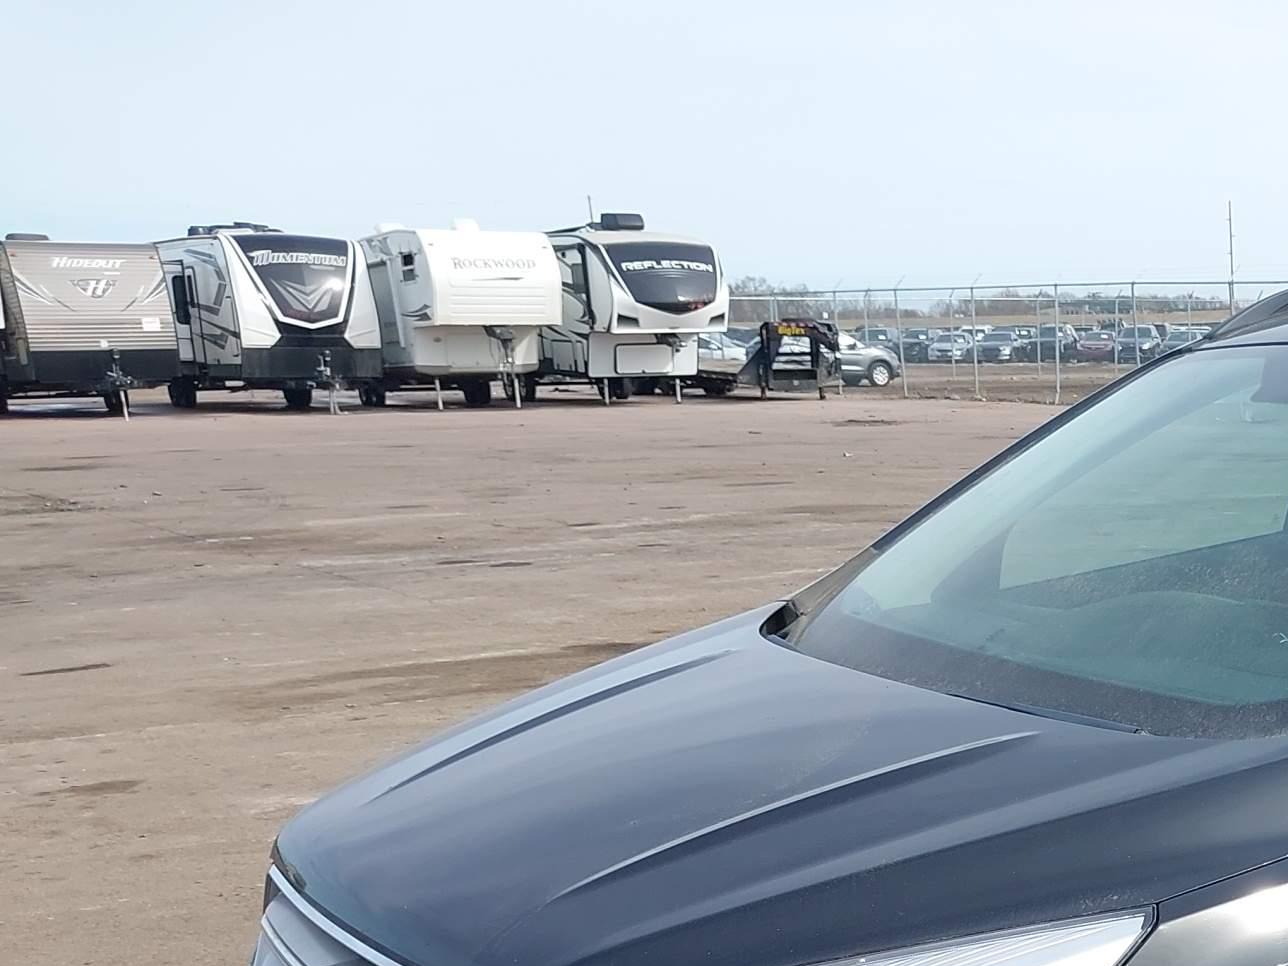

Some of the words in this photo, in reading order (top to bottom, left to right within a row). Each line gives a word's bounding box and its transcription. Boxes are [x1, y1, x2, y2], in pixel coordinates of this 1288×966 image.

[246, 249, 347, 266] MOMENTUM
[450, 256, 537, 270] ROCKWOOD
[620, 260, 714, 273] REFLECTION
